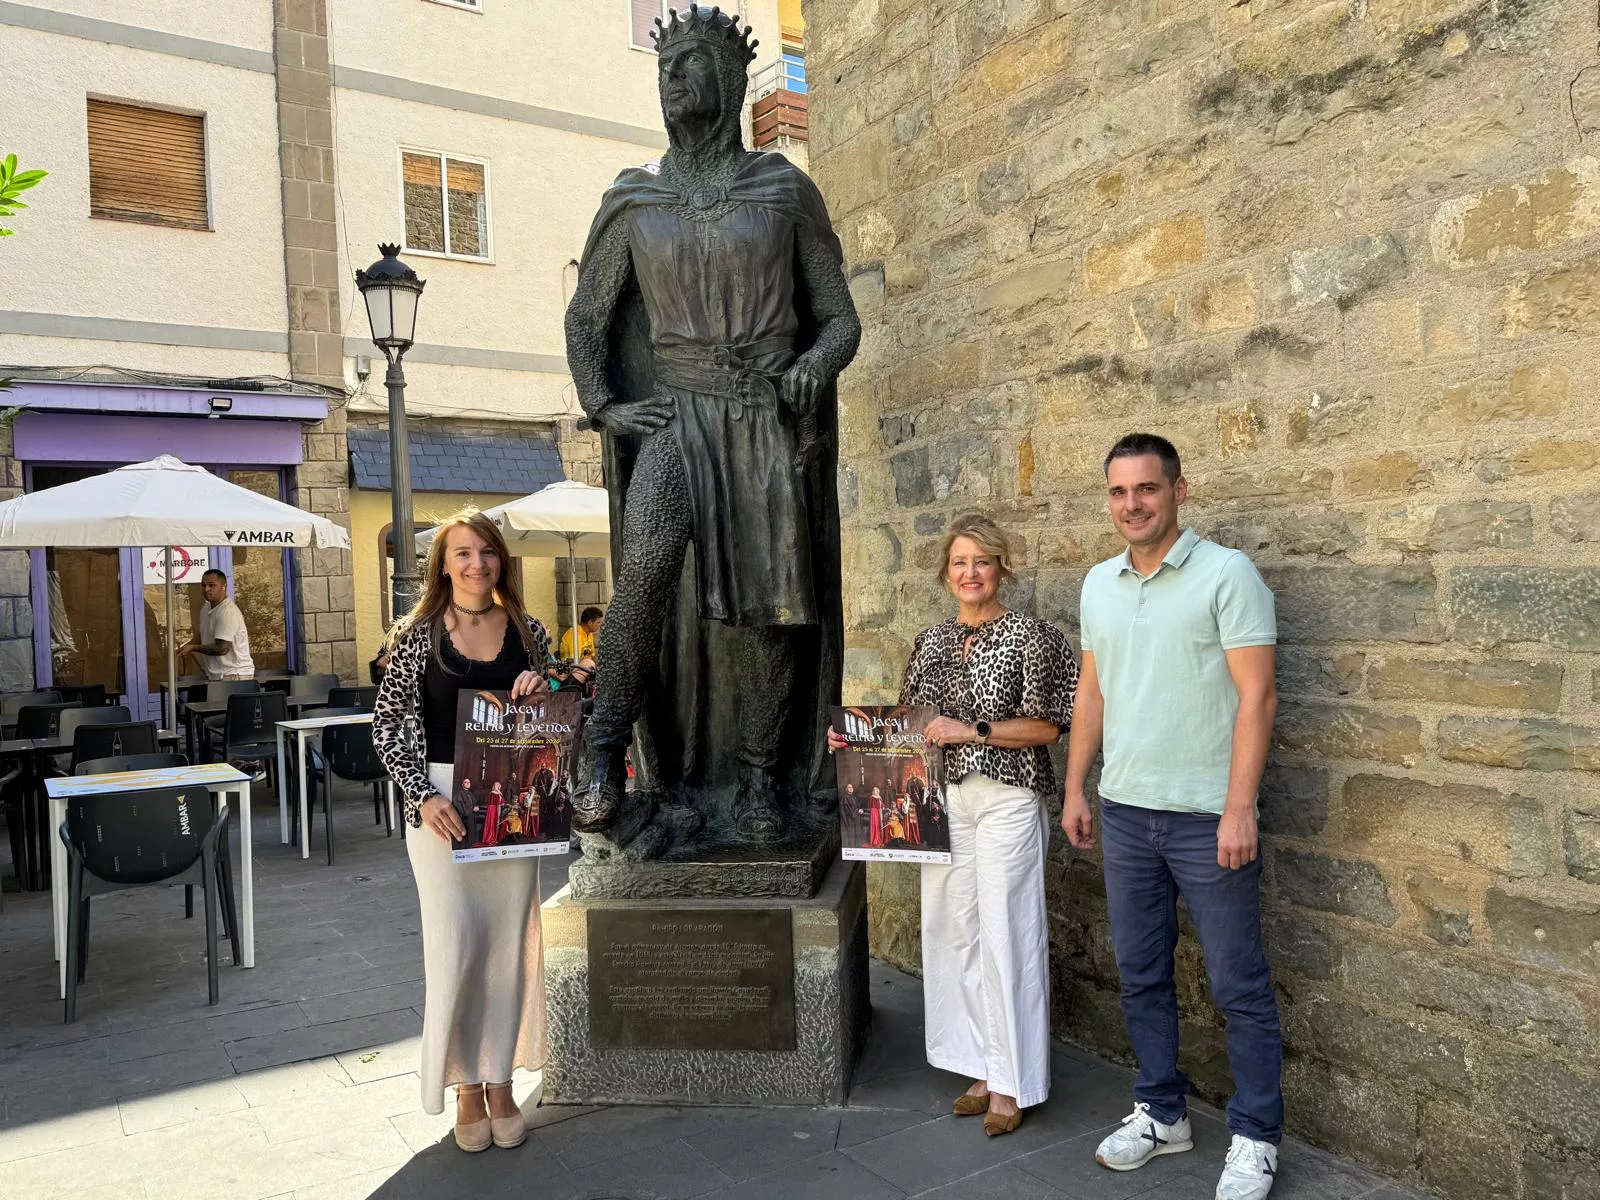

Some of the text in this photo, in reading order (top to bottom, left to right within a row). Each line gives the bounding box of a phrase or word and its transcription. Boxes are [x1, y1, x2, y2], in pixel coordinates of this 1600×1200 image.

[237, 530, 295, 543] AMBAR
[160, 558, 205, 567] MRBORE
[498, 703, 534, 718] Jaca
[869, 716, 900, 730] Jaca
[178, 802, 191, 835] AMBAR
